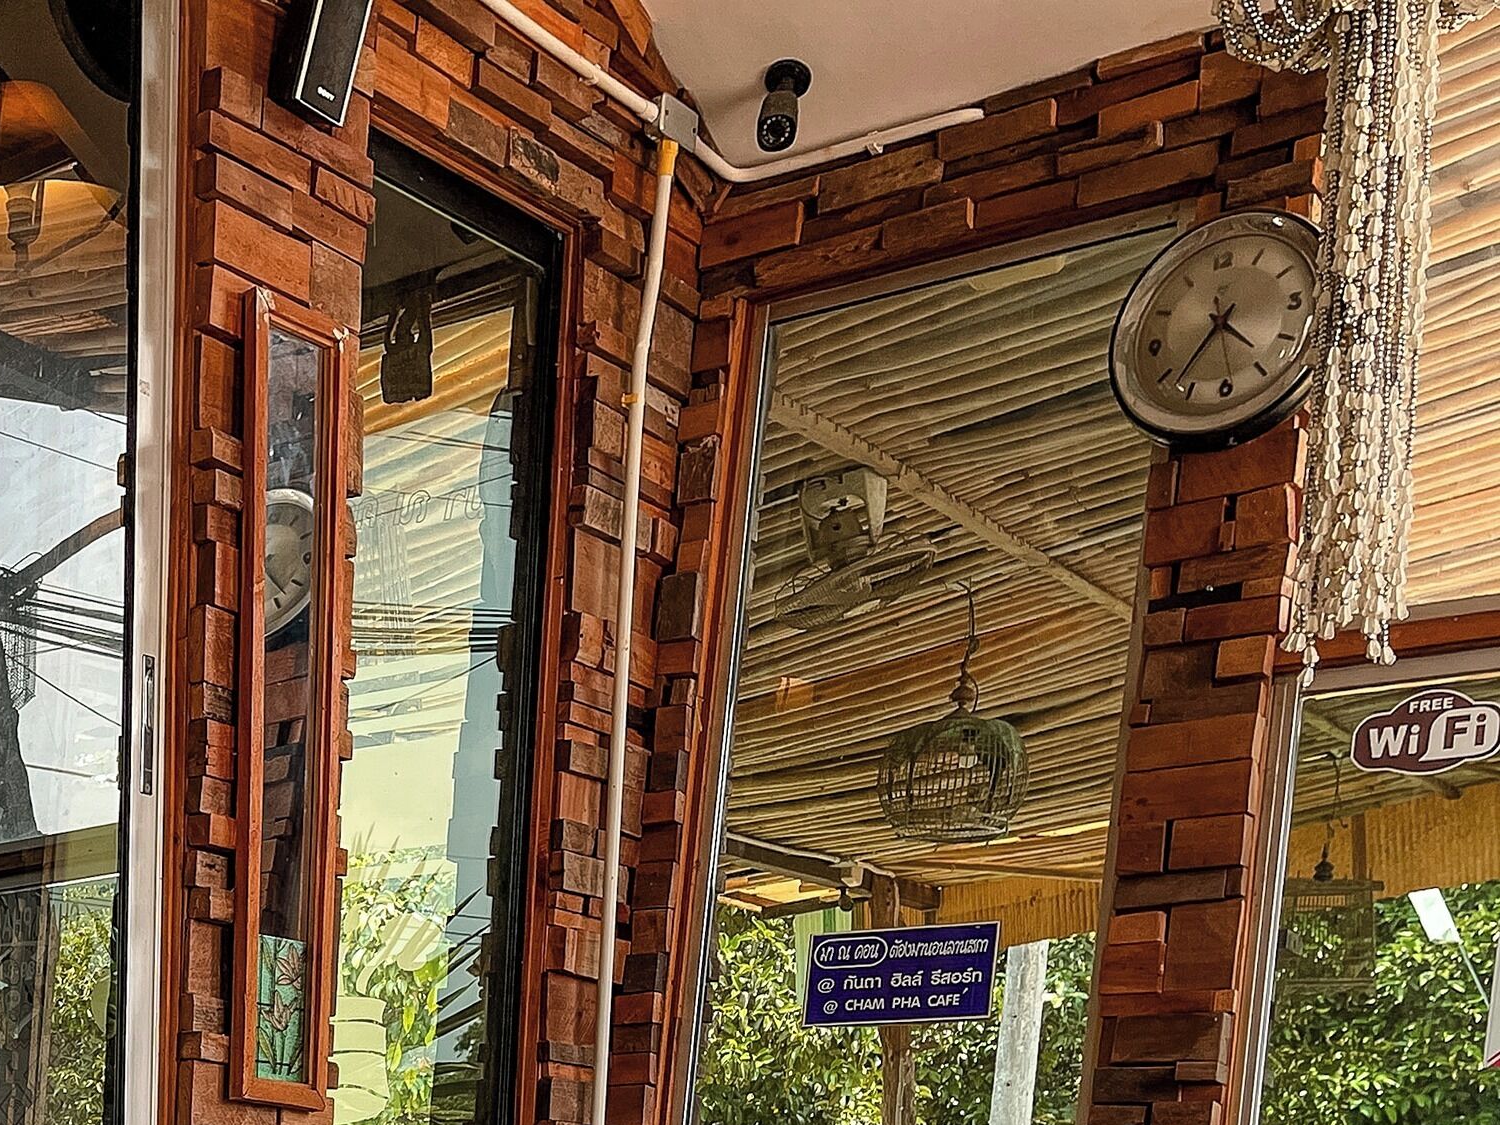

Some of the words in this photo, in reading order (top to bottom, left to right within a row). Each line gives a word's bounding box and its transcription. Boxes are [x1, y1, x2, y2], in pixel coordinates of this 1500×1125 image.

[1408, 696, 1454, 714] FREE
[890, 969, 924, 987] ฮิลล์
[930, 967, 983, 986] รีสอร์ท
[845, 998, 885, 1011] CHAM
[892, 995, 921, 1009] PHA
